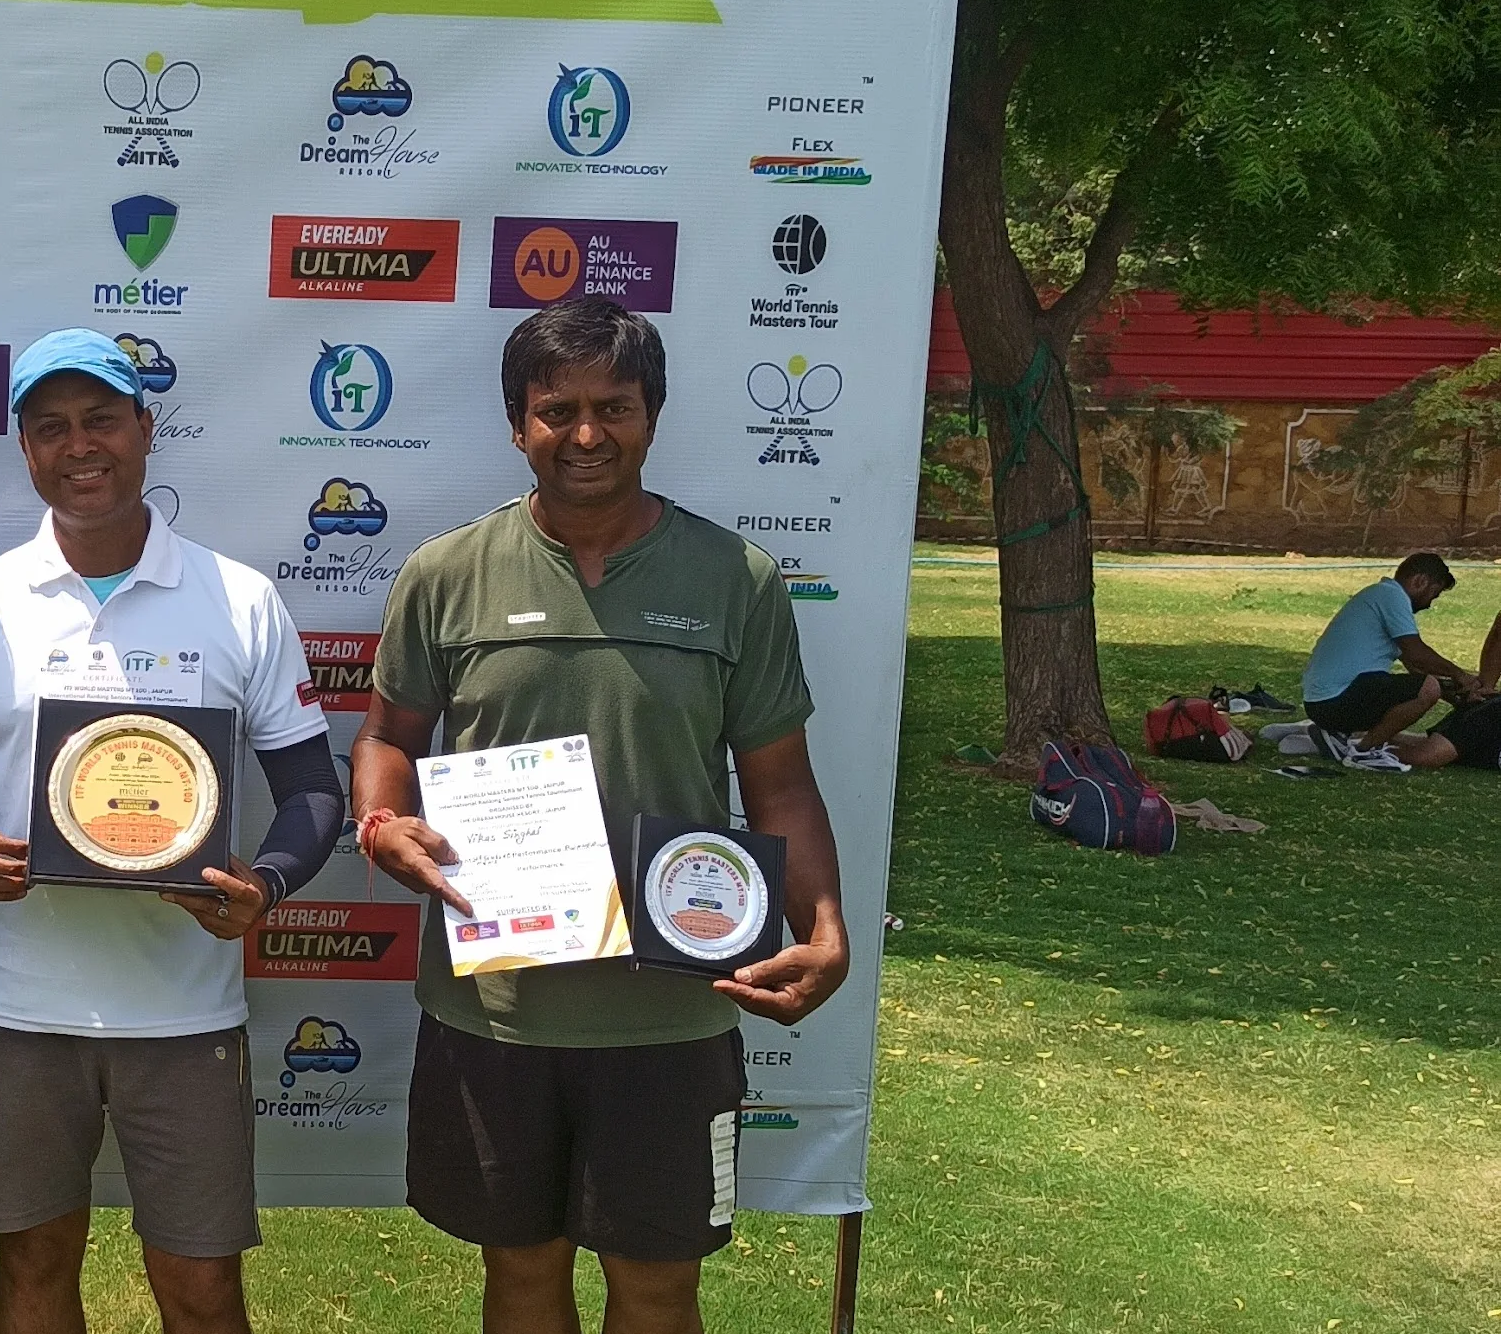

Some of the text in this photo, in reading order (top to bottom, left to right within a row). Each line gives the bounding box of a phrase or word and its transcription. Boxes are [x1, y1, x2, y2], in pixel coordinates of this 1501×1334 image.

[768, 97, 863, 113] PIONEER
[128, 116, 168, 125] ALL INDIA
[104, 126, 192, 137] TENNIS ASSOCIATION
[353, 135, 369, 144] The
[793, 138, 833, 151] FLEX
[126, 152, 170, 166] AITA
[300, 126, 440, 179] Dream House
[340, 168, 392, 176] RESORT
[516, 162, 667, 175] INNOVATEX TECHNOLOGY
[753, 166, 866, 177] MADE IN INDIA
[301, 225, 388, 245] EVEREADY
[588, 236, 609, 249] AU
[300, 252, 409, 276] ULTIMA
[587, 251, 636, 264] SMALL
[586, 266, 652, 280] FINANCE
[95, 278, 188, 305] métier
[299, 281, 364, 291] ALKALINE
[585, 281, 627, 294] BANK
[752, 299, 838, 313] World Tennis
[750, 314, 838, 328] Masters Tour
[280, 437, 430, 449] INNOVATEX TECHNOLOGY
[737, 516, 830, 532] PIONEER
[126, 658, 156, 671] ITF
[102, 741, 138, 755] TENNIS
[142, 741, 183, 770] MASTERS
[78, 754, 101, 781] WORLD
[511, 755, 540, 771] ITF
[76, 785, 84, 799] ITF
[266, 906, 351, 927] EVEREADY
[266, 934, 373, 957] ULTIMA
[265, 962, 328, 971] ALKALINE
[305, 1091, 321, 1099] The
[256, 1081, 387, 1132] Dream House
